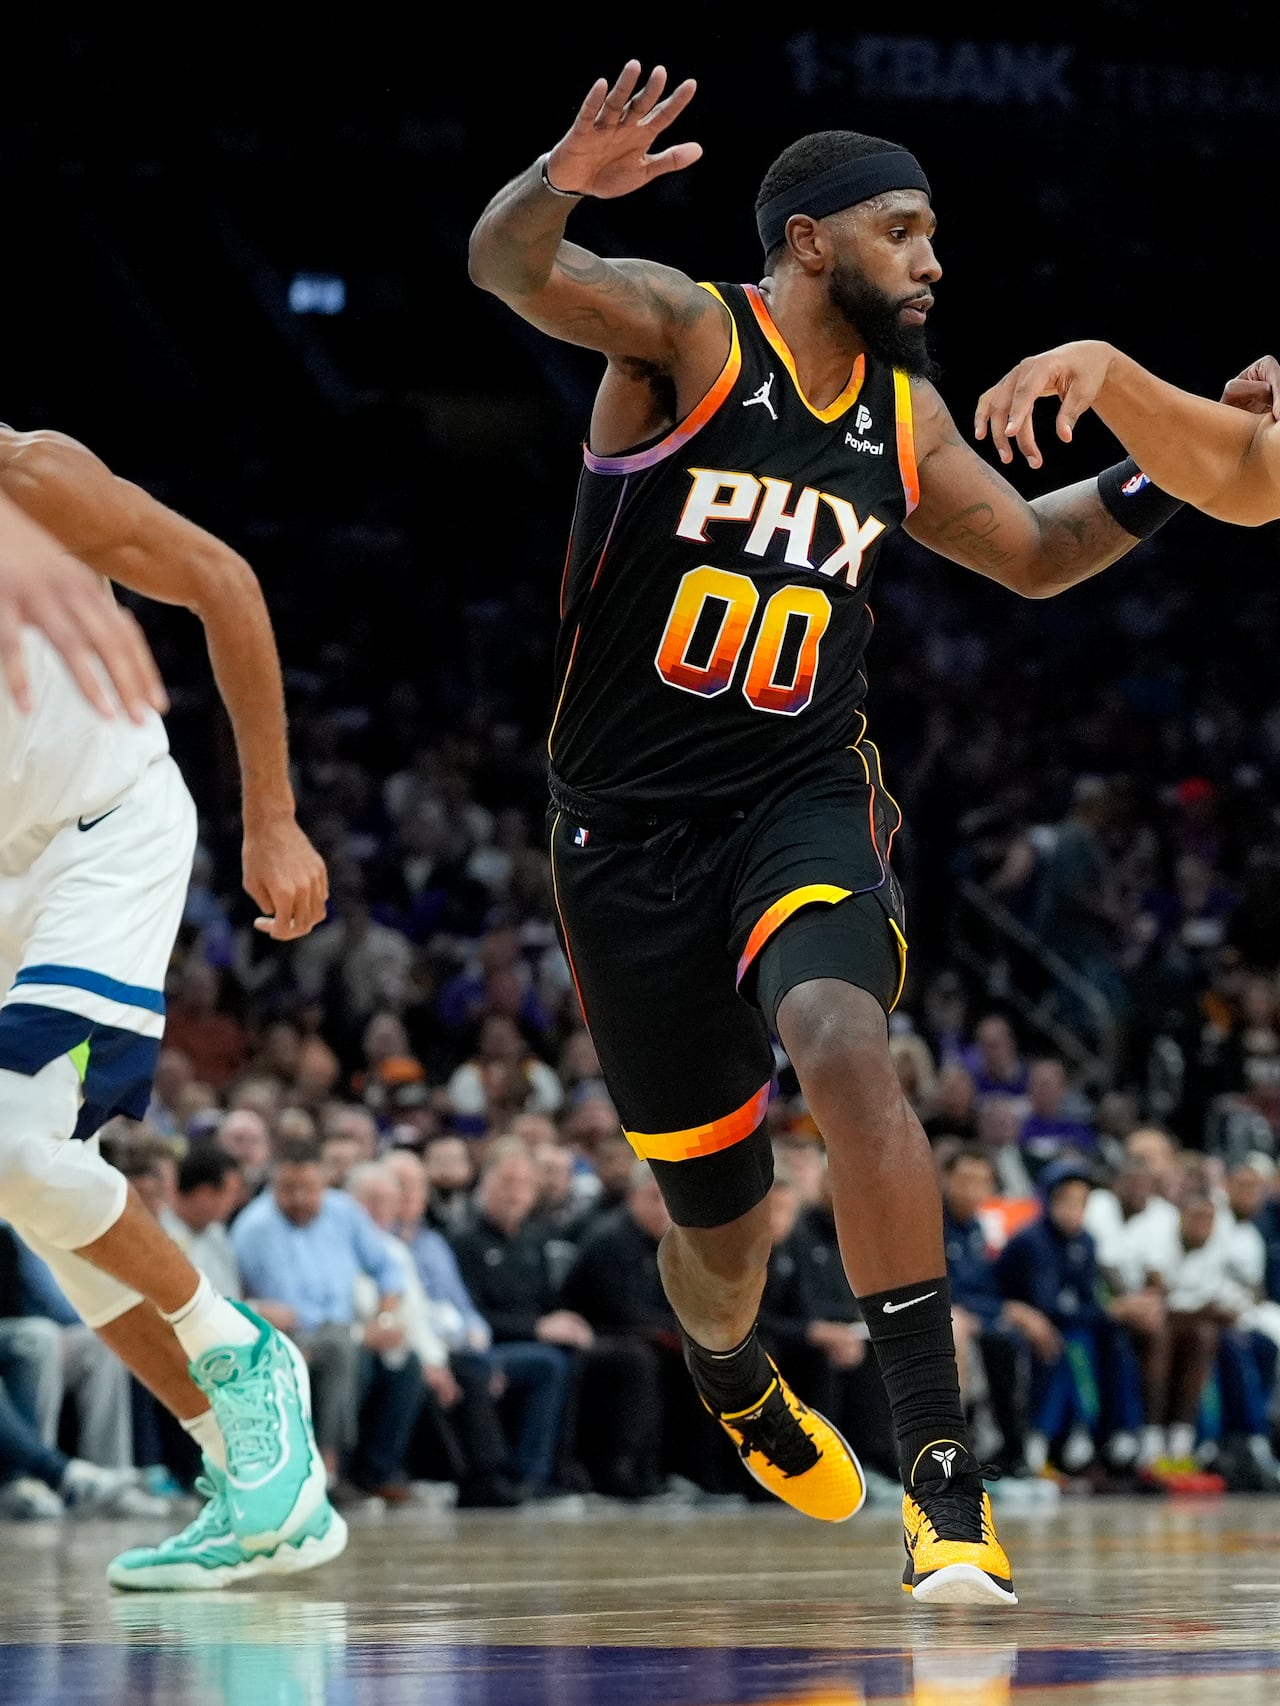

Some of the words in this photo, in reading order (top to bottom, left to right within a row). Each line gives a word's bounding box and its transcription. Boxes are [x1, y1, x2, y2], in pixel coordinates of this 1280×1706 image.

[844, 431, 884, 456] PayPal
[674, 466, 888, 591] PHX
[654, 564, 833, 717] 00
